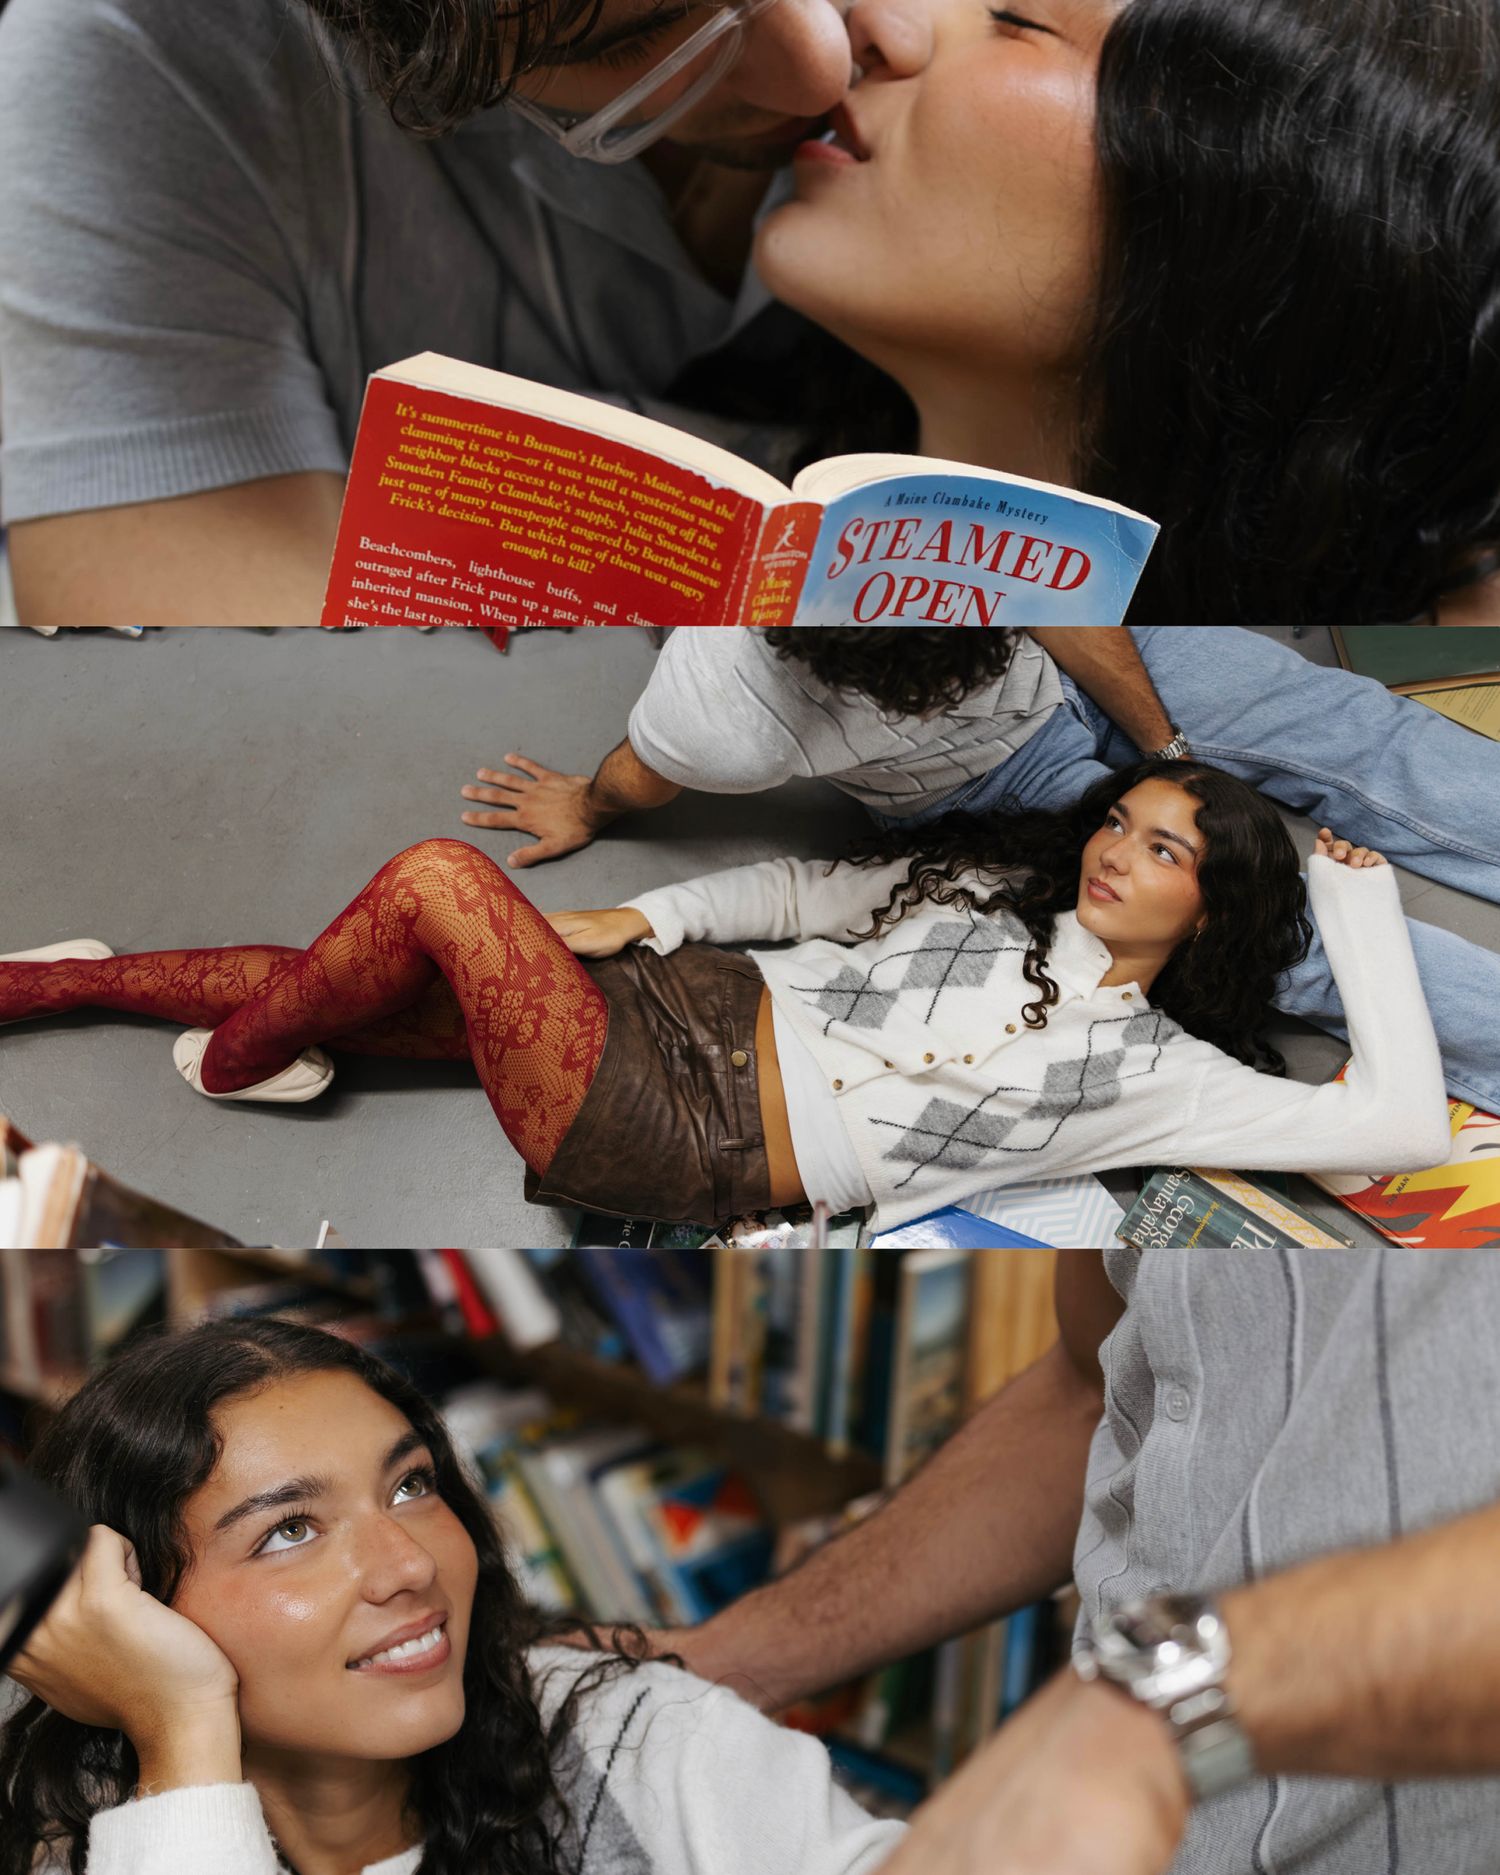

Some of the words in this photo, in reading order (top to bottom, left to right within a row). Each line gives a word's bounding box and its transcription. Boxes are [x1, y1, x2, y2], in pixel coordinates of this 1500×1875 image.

[396, 402, 417, 418] It's
[420, 413, 503, 440] summertime
[506, 430, 520, 443] in
[524, 434, 587, 463] Busman's
[589, 454, 639, 482] Harbor,
[642, 472, 687, 501] Maine,
[689, 494, 715, 511] and
[715, 504, 736, 521] the
[399, 444, 457, 465] neighbor
[460, 454, 501, 475] blocks
[503, 469, 546, 487] access
[548, 480, 561, 491] to
[565, 483, 586, 499] the
[589, 490, 630, 516] beach,
[633, 511, 678, 535] cutting
[679, 528, 699, 543] off
[697, 535, 718, 550] the
[400, 423, 466, 450] clamming
[469, 439, 480, 451] is
[543, 459, 554, 472] it
[557, 465, 583, 480] was
[585, 475, 618, 492] until
[619, 486, 628, 496] a
[630, 490, 696, 523] mysterious
[698, 518, 724, 534] new
[378, 473, 405, 487] just
[408, 481, 432, 494] one
[434, 486, 450, 500] of
[450, 491, 488, 509] many
[490, 501, 569, 531] townspeople
[571, 525, 622, 549] angered
[623, 536, 640, 555] by
[642, 546, 721, 589] Bartholomew
[385, 456, 444, 480] Snowden
[448, 470, 495, 493] Family
[498, 482, 571, 513] Clambake's
[573, 507, 618, 530] supply.
[620, 521, 653, 541] Julia
[655, 534, 709, 566] Snowden
[711, 558, 722, 571] is
[885, 493, 892, 507] A
[896, 493, 927, 504] Maine
[932, 491, 991, 511] Clambake
[996, 499, 1049, 525] Mystery
[359, 535, 456, 570] Beachcombers,
[468, 560, 536, 590] lighthouse
[546, 581, 583, 605] buffs,
[593, 601, 617, 616] and
[625, 612, 660, 626] clam
[390, 492, 435, 512] Frick's
[437, 504, 495, 527] decision.
[499, 519, 525, 535] But
[526, 529, 567, 549] which
[569, 542, 592, 556] one
[594, 550, 610, 563] of
[609, 554, 641, 574] them
[643, 569, 669, 585] was
[669, 581, 705, 602] angry
[501, 540, 548, 561] enough
[551, 553, 565, 565] to
[566, 556, 596, 574] kill?
[827, 517, 1092, 591] STEAMED
[347, 597, 378, 613] she's
[381, 602, 402, 617] the
[404, 606, 427, 621] last
[429, 614, 442, 625] to
[351, 577, 411, 598] inherited
[415, 592, 473, 612] mansion.
[480, 604, 518, 625] When
[355, 560, 413, 579] outraged
[415, 571, 448, 586] after
[451, 576, 485, 595] Frick
[489, 588, 518, 604] puts
[521, 598, 539, 611] up
[541, 604, 550, 613] a
[552, 608, 579, 622] gate
[853, 571, 1007, 626] OPEN
[1131, 1166, 1191, 1245] Santayana
[1149, 1195, 1195, 1248] George
[1395, 1176, 1411, 1193] MAN
